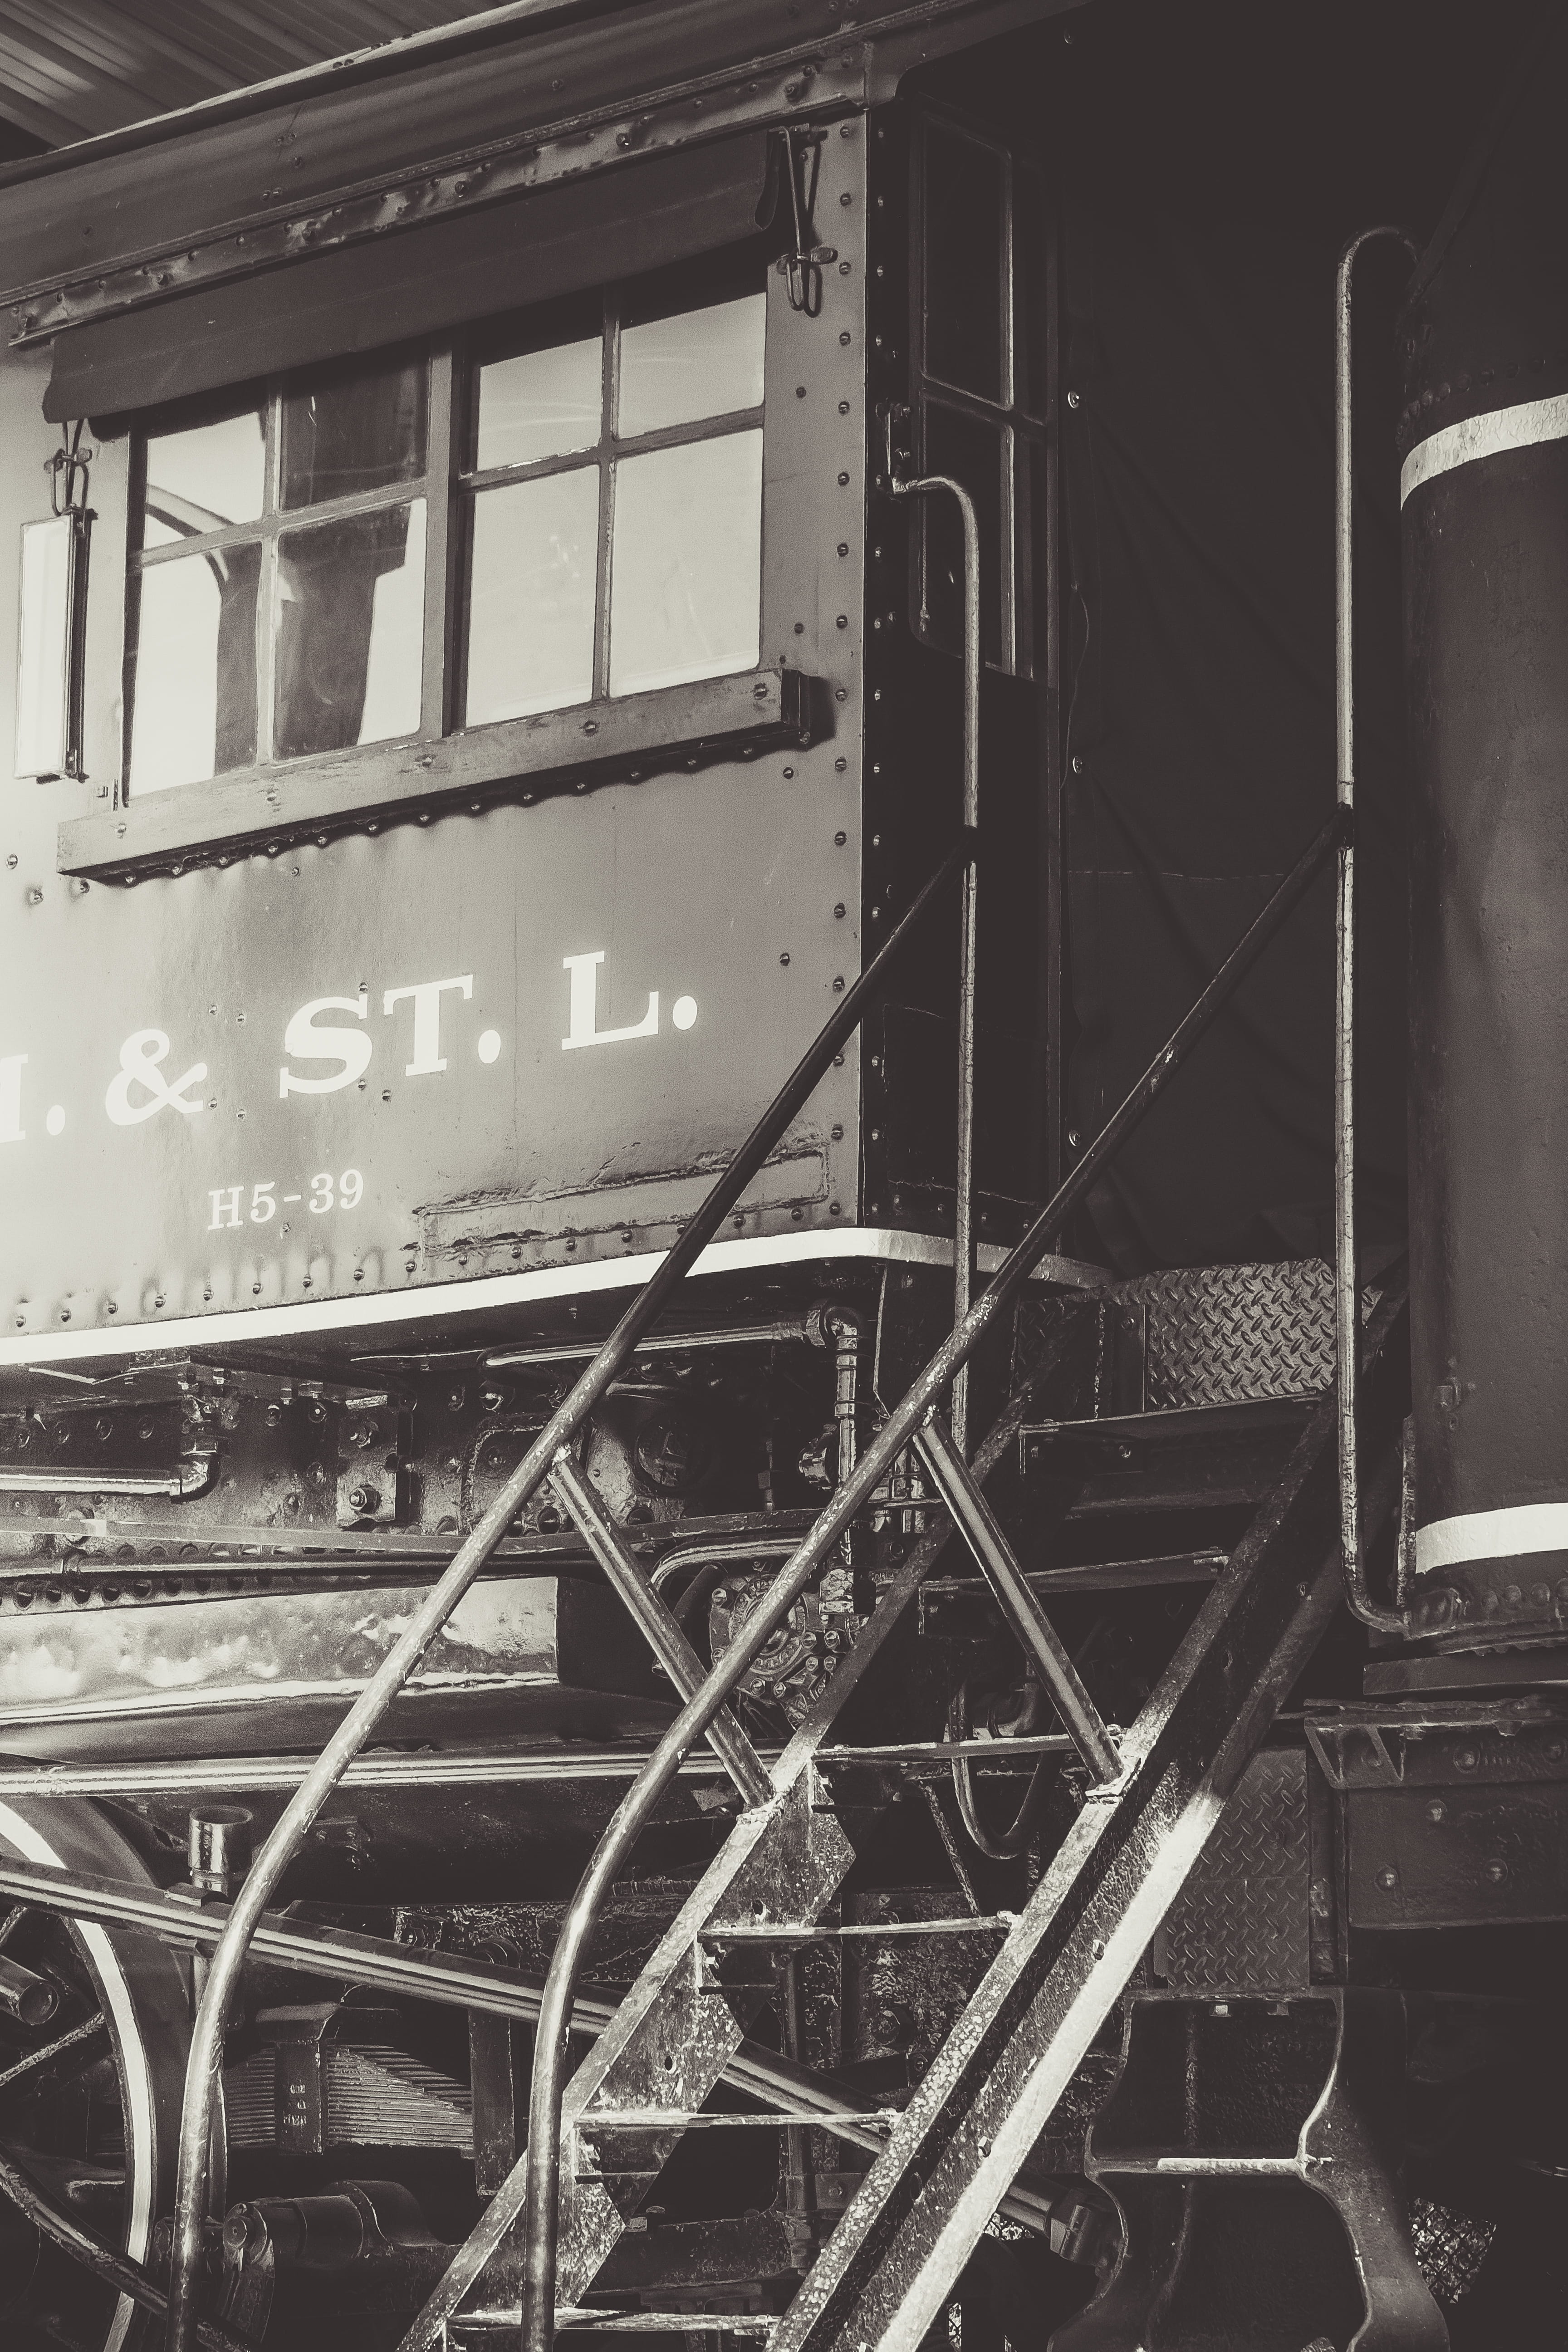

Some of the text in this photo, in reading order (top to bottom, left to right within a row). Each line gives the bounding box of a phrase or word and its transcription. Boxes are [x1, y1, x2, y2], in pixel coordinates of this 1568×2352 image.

[105, 1029, 208, 1126] &
[279, 974, 501, 1098] ST.
[562, 951, 698, 1050] L.
[207, 1169, 363, 1230] H5-39
